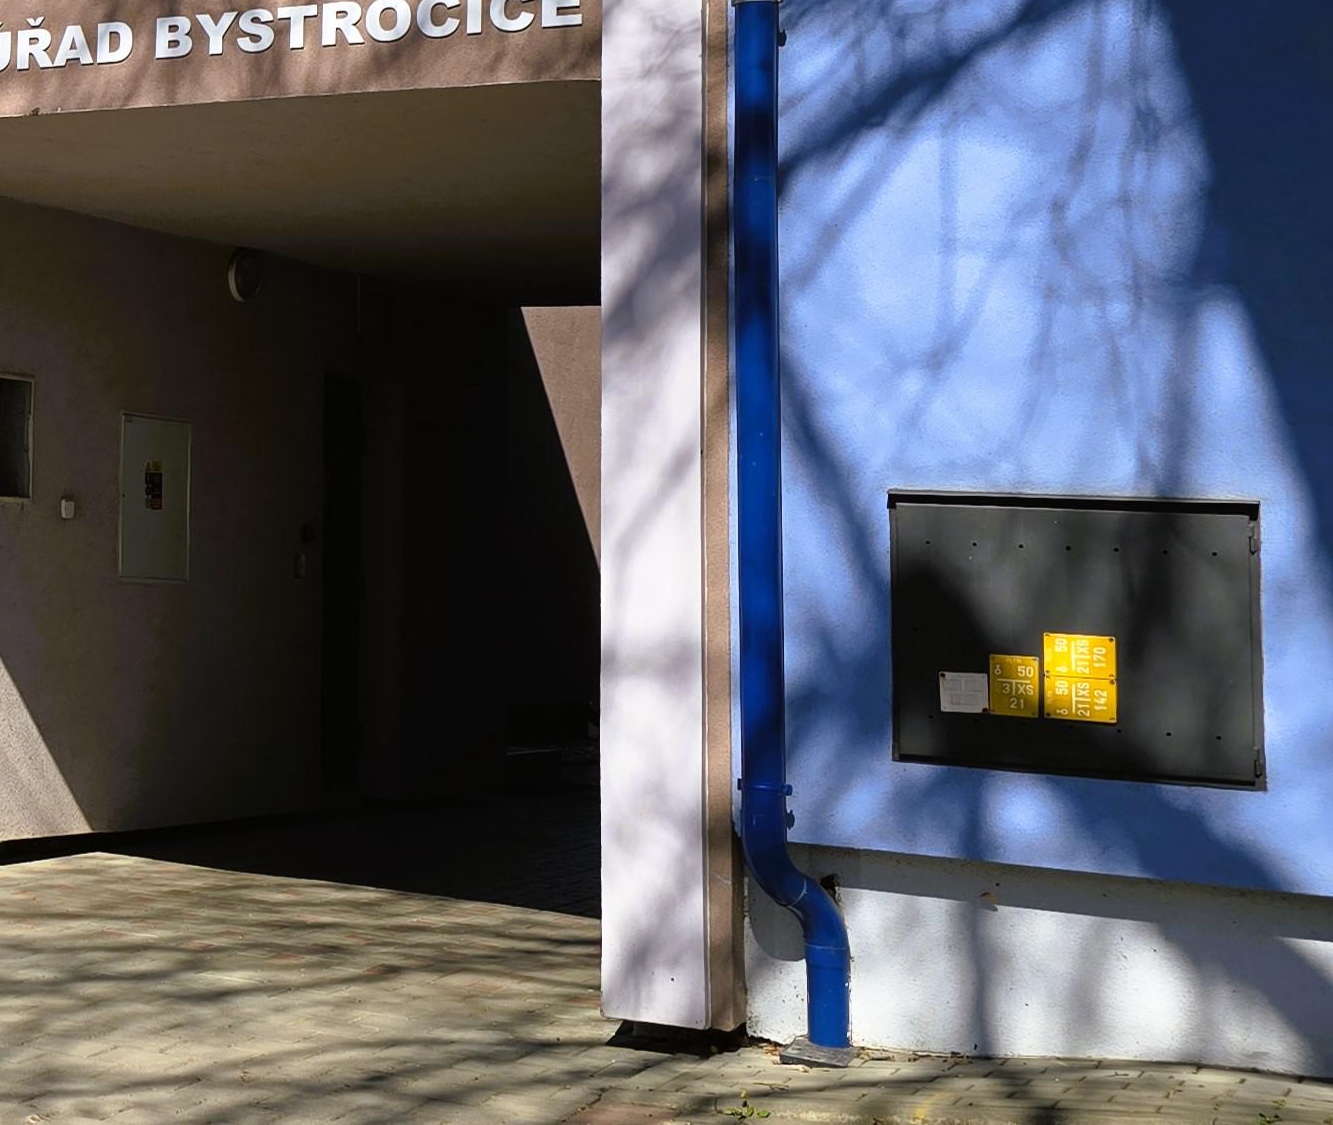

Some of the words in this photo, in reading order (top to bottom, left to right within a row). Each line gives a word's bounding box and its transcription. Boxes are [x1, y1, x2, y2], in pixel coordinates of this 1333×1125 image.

[1055, 638, 1068, 652] 50
[1093, 647, 1106, 668] 170
[1017, 665, 1034, 678] 50
[1002, 683, 1010, 694] 3
[1055, 680, 1069, 695] 50
[1009, 698, 1025, 709] 21
[1094, 690, 1108, 711] 142
[1077, 701, 1090, 716] 21
